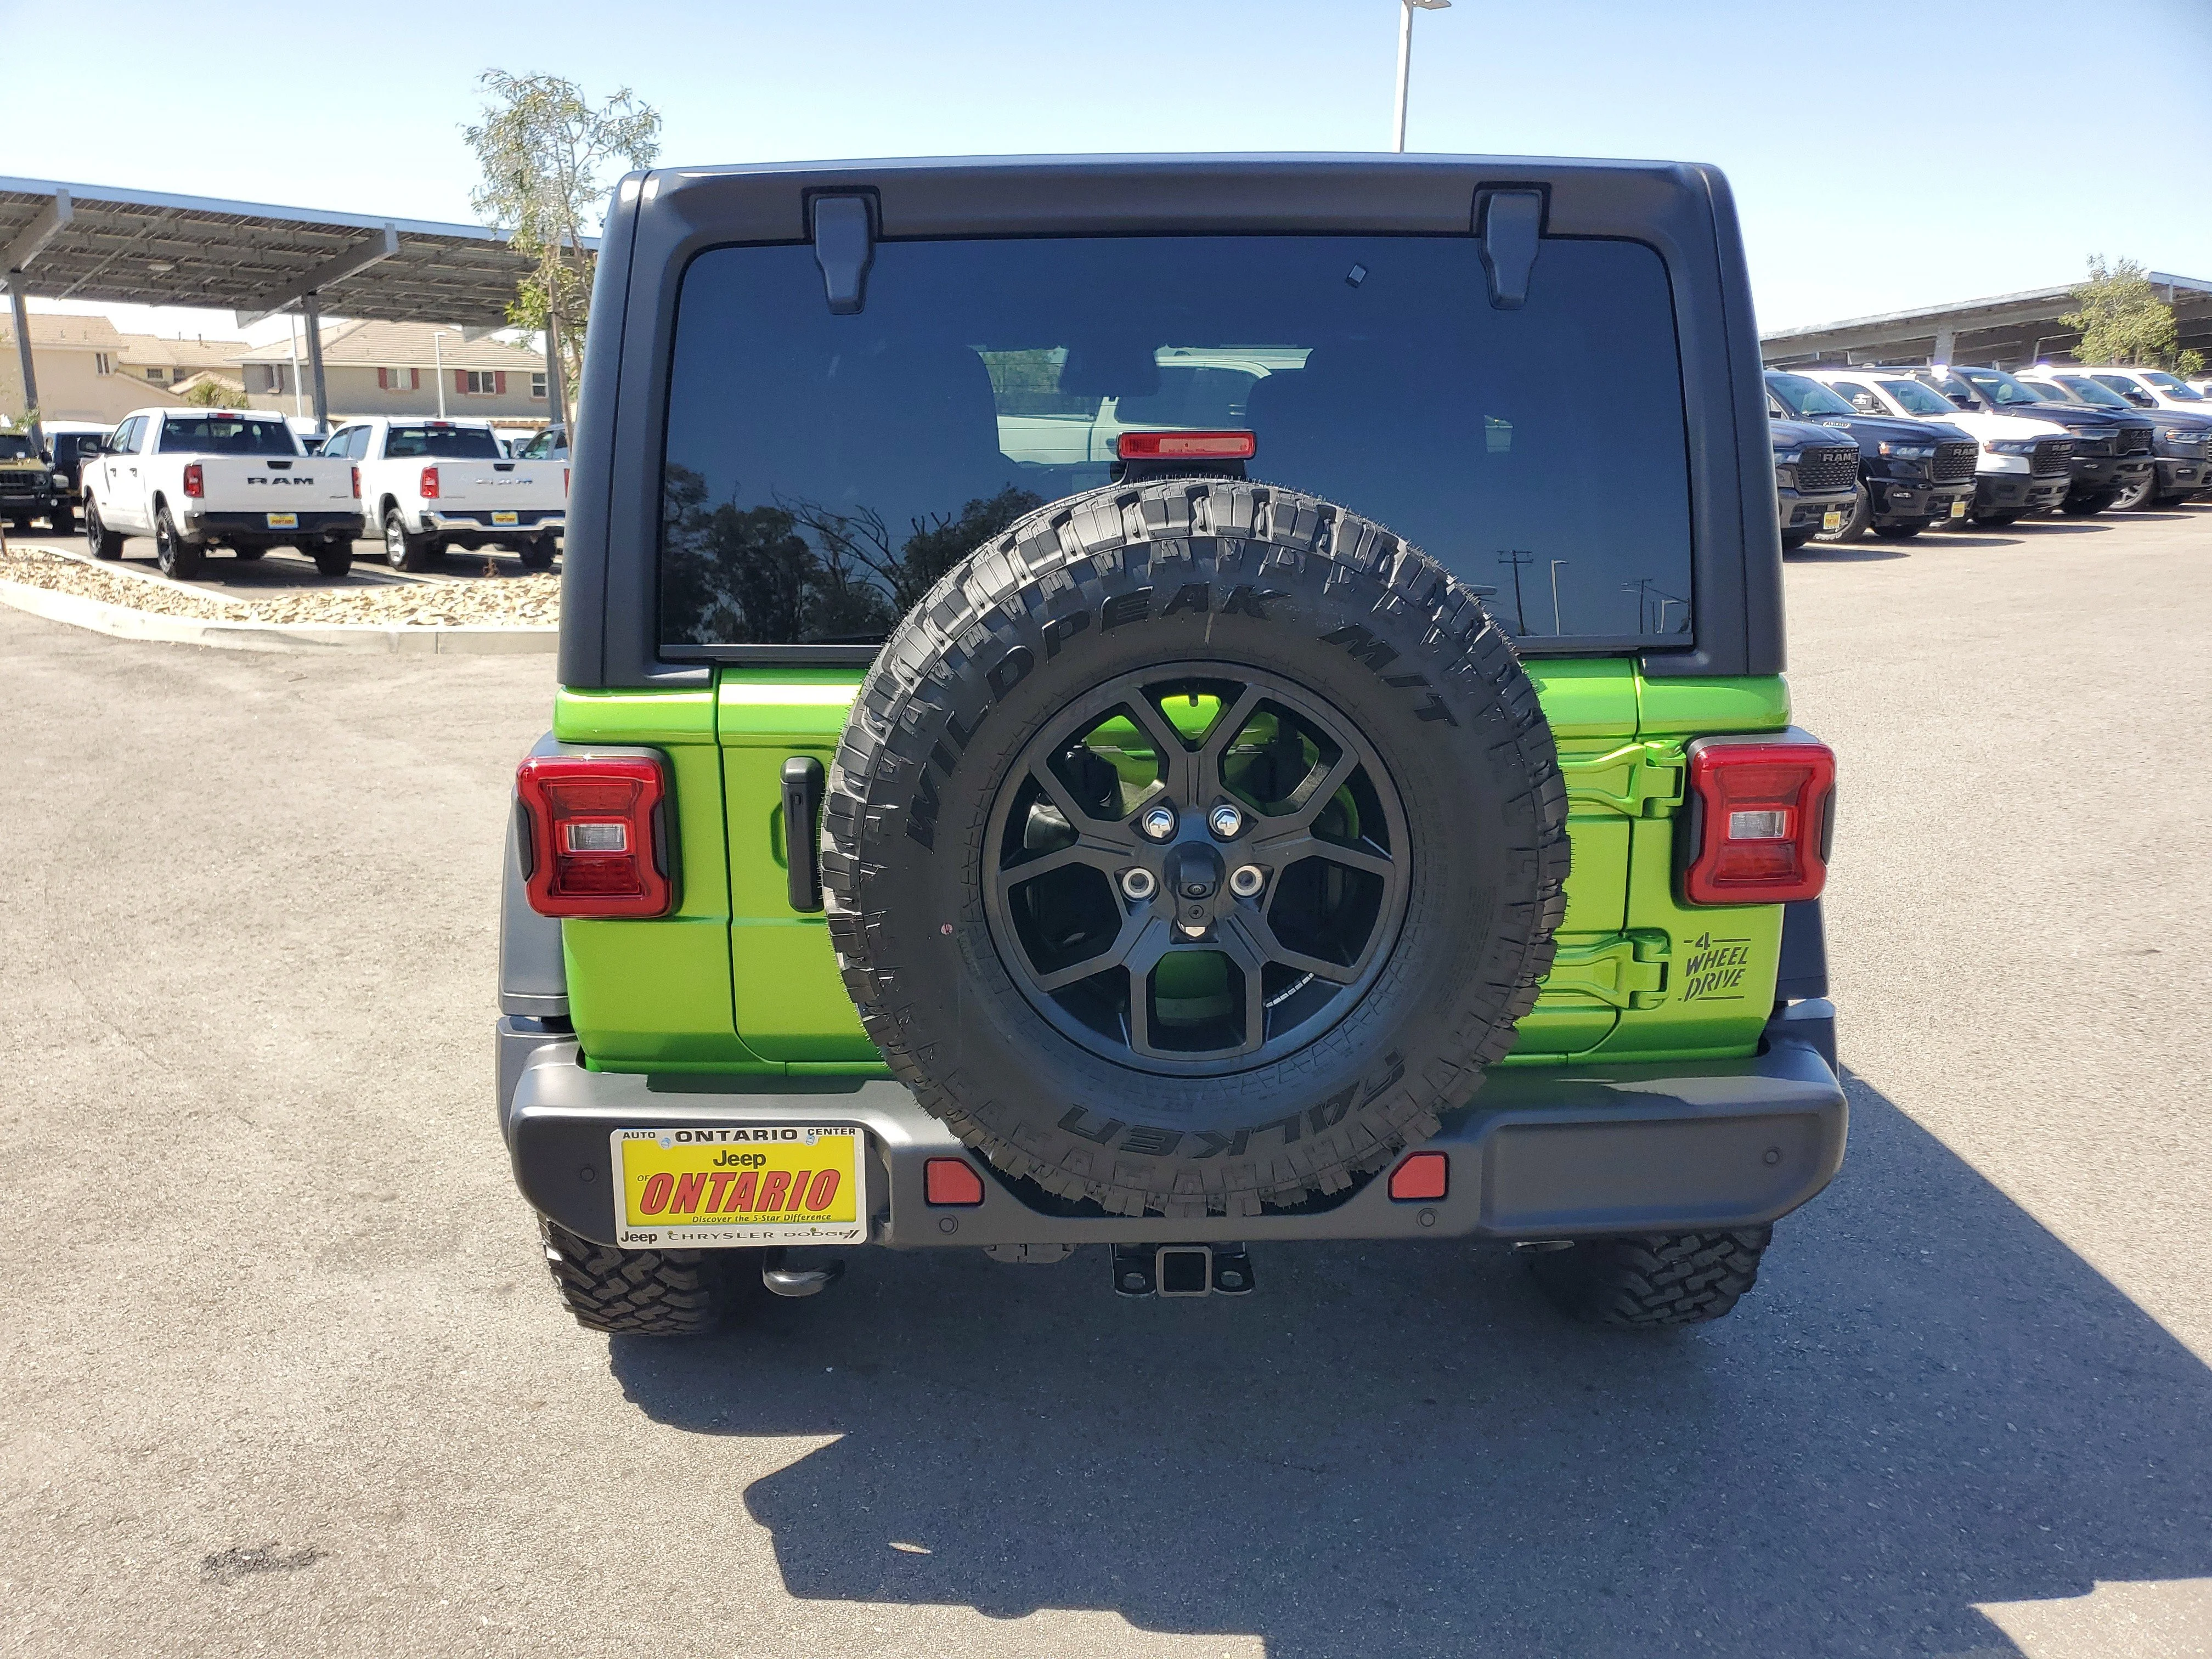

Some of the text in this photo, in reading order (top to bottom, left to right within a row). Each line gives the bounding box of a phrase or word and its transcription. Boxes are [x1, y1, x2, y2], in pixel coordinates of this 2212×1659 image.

[1823, 453, 1852, 462] RAM
[904, 581, 1459, 854] WILDPEAK M/T
[1695, 932, 1711, 951] 4
[1685, 946, 1750, 978] WHEEL
[1683, 968, 1746, 1003] DRIVE
[622, 1131, 656, 1139] AUTO
[675, 1128, 798, 1142] ONTARIO
[713, 1149, 766, 1170] Jeep
[639, 1169, 841, 1215] ONTARIO
[783, 1214, 832, 1222] Difference
[620, 1231, 658, 1244] Jeep
[668, 1232, 774, 1240] CHRYSLER
